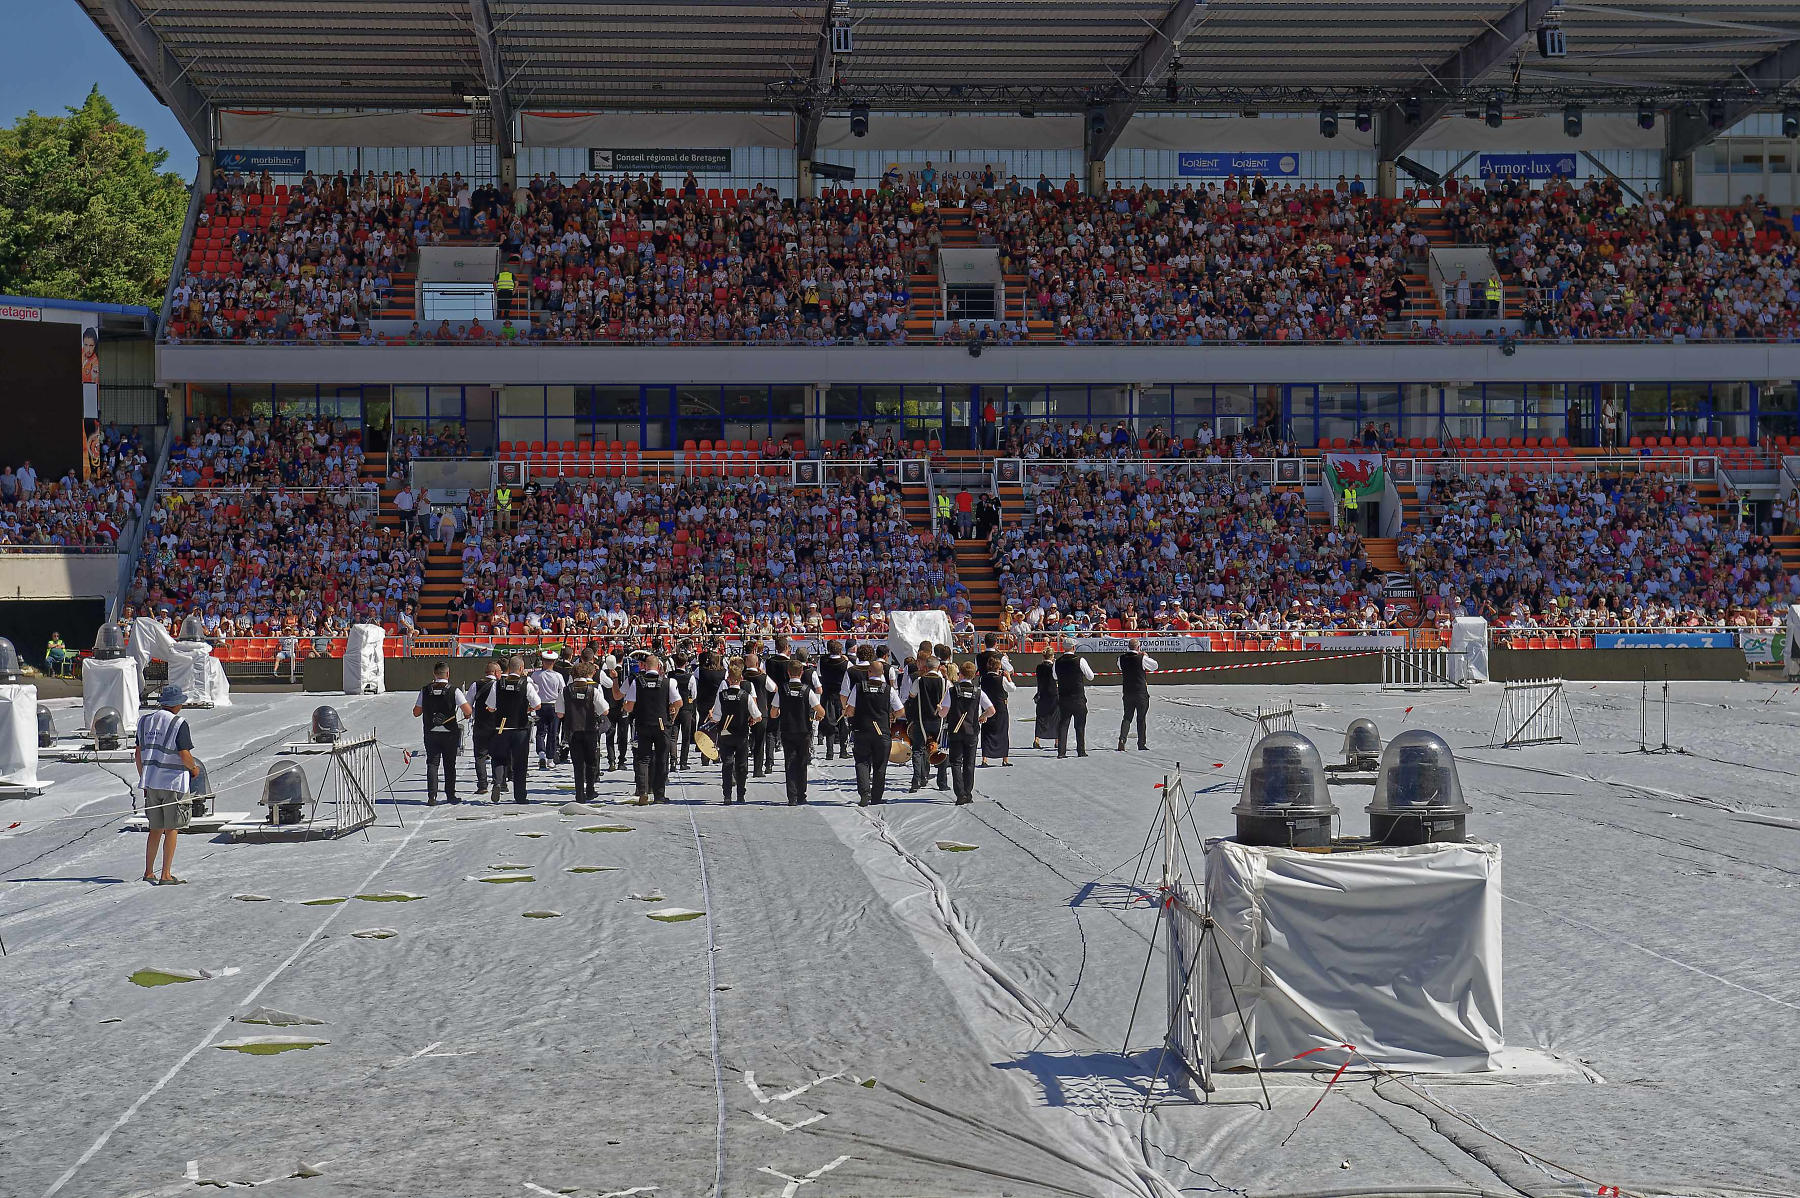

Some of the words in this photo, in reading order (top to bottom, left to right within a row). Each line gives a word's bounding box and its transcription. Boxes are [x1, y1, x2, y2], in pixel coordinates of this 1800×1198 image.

[251, 156, 301, 165] morbihan.fr
[616, 153, 645, 162] Conseil
[646, 153, 678, 164] régional
[679, 154, 689, 162] de
[691, 154, 726, 164] Bretagne
[942, 170, 953, 179] de
[1389, 590, 1416, 598] LORIENT
